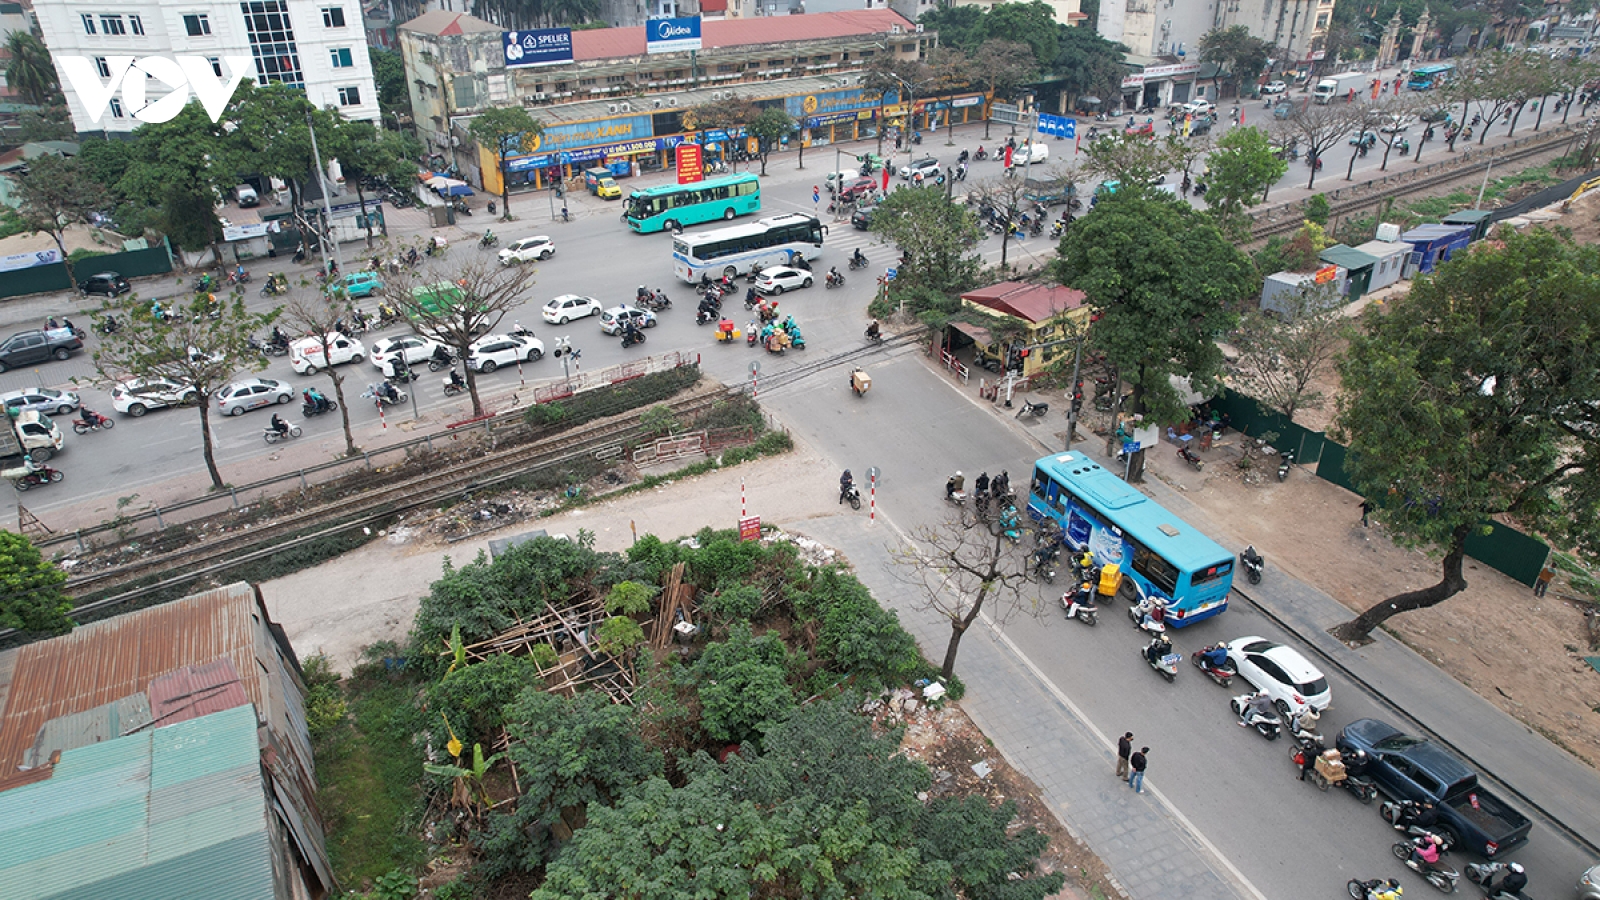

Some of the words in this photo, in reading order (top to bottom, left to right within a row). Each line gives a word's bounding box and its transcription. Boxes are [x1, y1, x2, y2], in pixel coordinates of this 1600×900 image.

[659, 21, 691, 39] Midea
[538, 33, 569, 44] SPELIER
[596, 123, 632, 138] XANH
